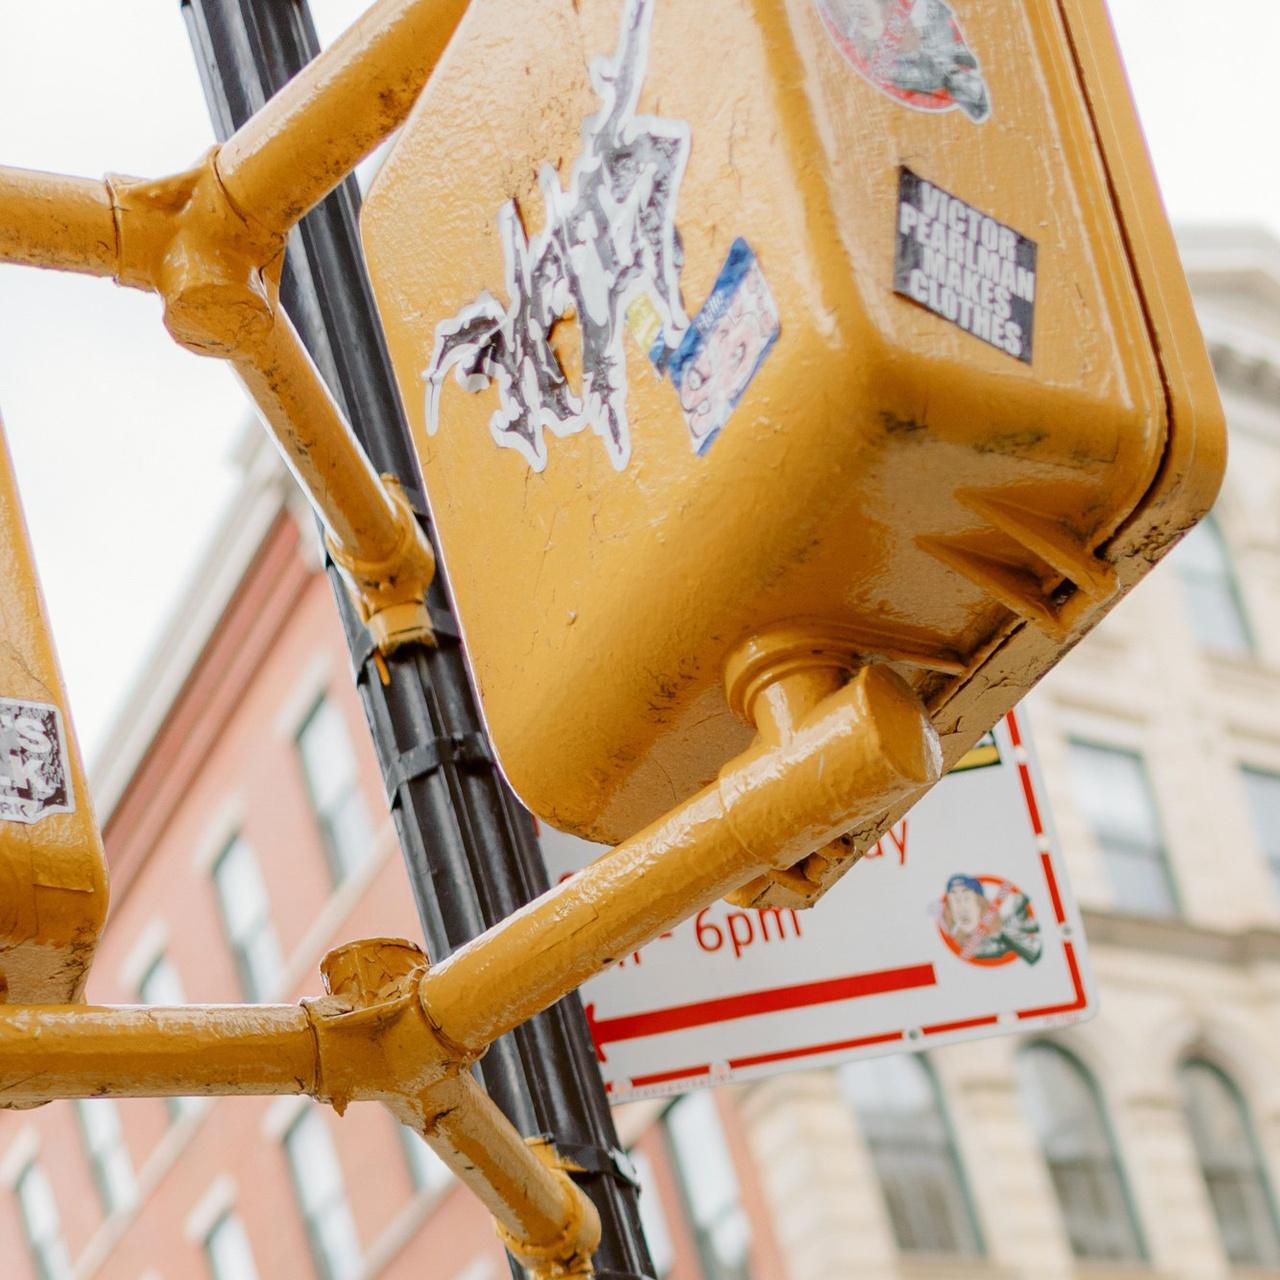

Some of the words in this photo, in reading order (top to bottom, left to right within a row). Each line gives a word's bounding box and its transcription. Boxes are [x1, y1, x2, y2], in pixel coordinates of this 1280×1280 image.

[900, 202, 1035, 303] PEARLMAN
[920, 181, 1017, 261] VICTOR
[910, 268, 1022, 357] CLOTHES
[923, 248, 1012, 320] MAKES
[694, 907, 802, 959] 6pm
